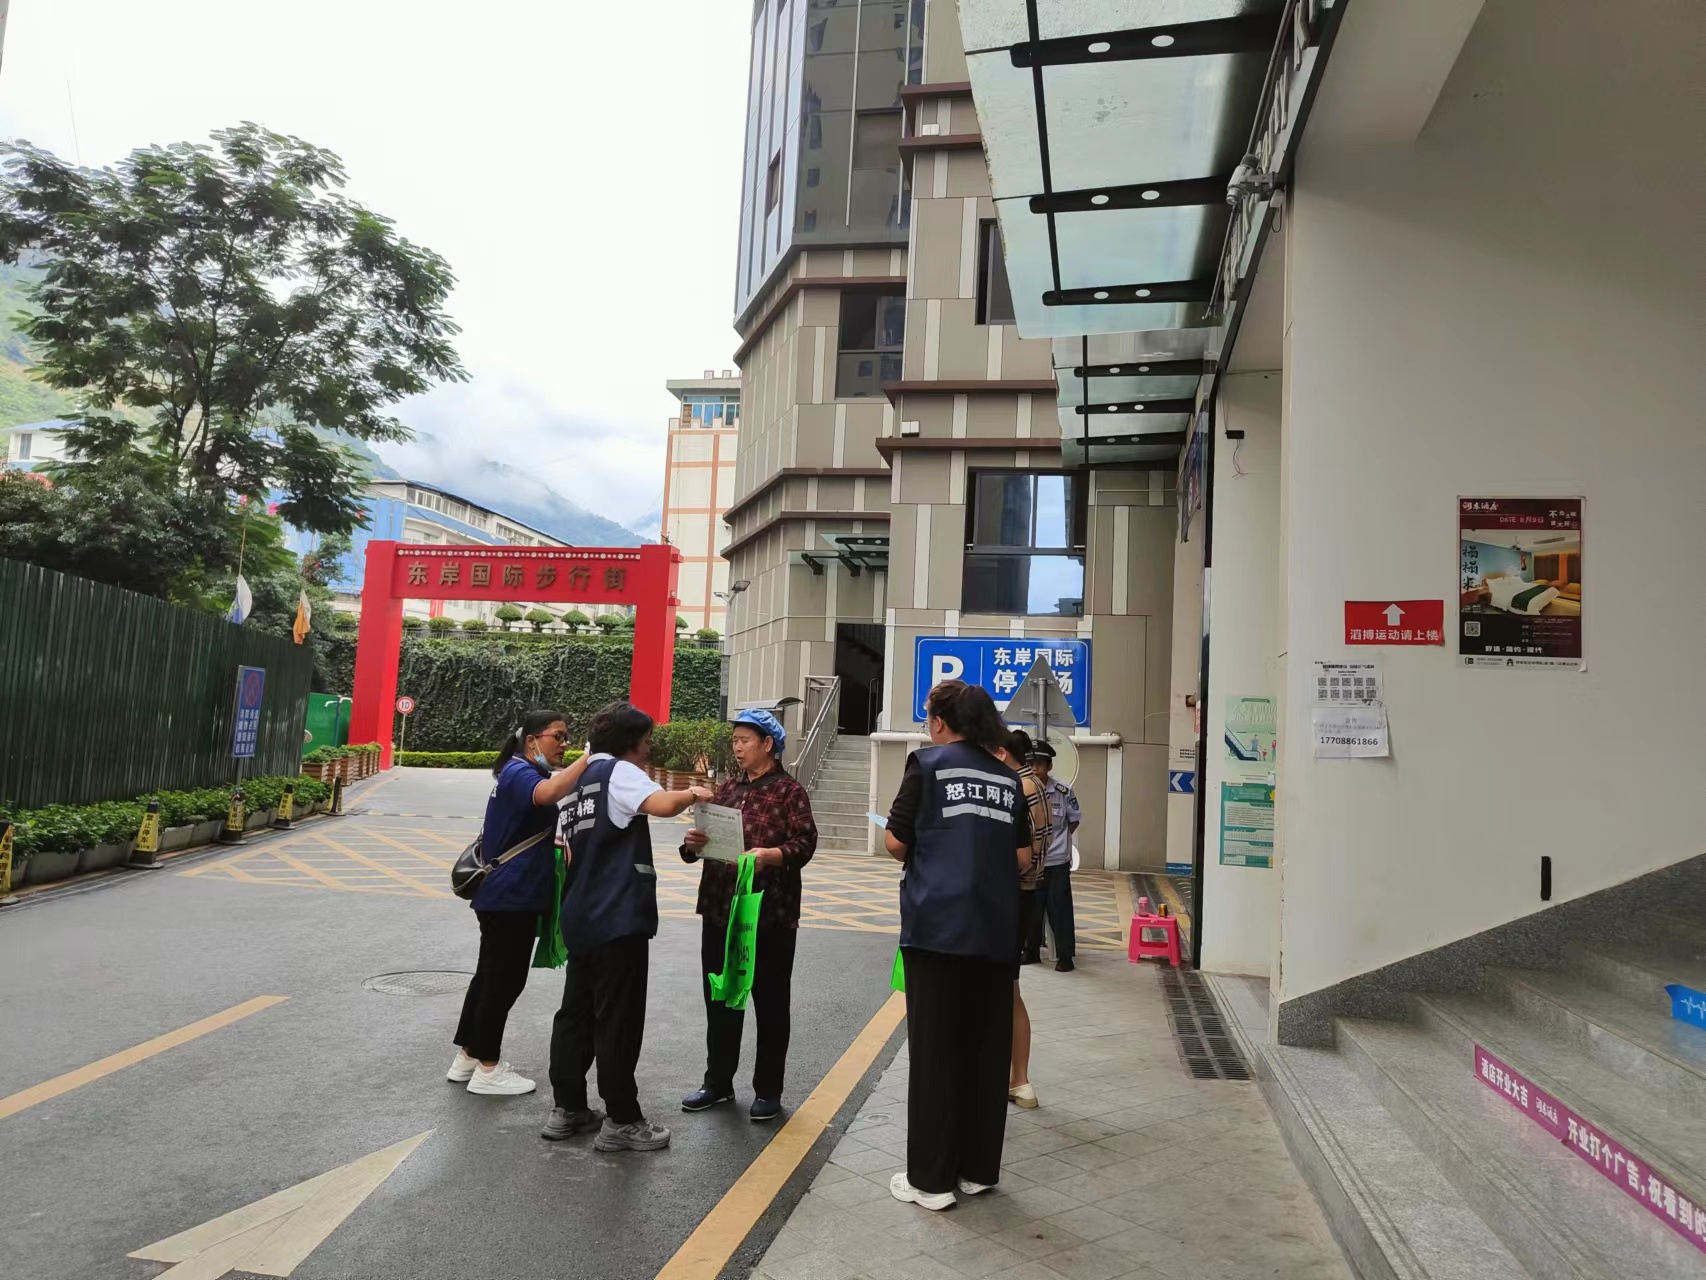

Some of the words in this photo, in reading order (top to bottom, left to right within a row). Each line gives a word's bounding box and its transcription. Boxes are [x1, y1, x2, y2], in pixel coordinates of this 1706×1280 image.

[407, 561, 627, 592] 东岸国际步行街
[1350, 629, 1439, 641] 滔搏运动请上楼
[993, 647, 1074, 667] 东岸国际
[992, 669, 1073, 695] 停场
[400, 701, 410, 710] 10
[1320, 736, 1379, 746] 17708861866
[945, 783, 1015, 809] 怒江网格
[1481, 1057, 1529, 1108] 酒店开业大吉
